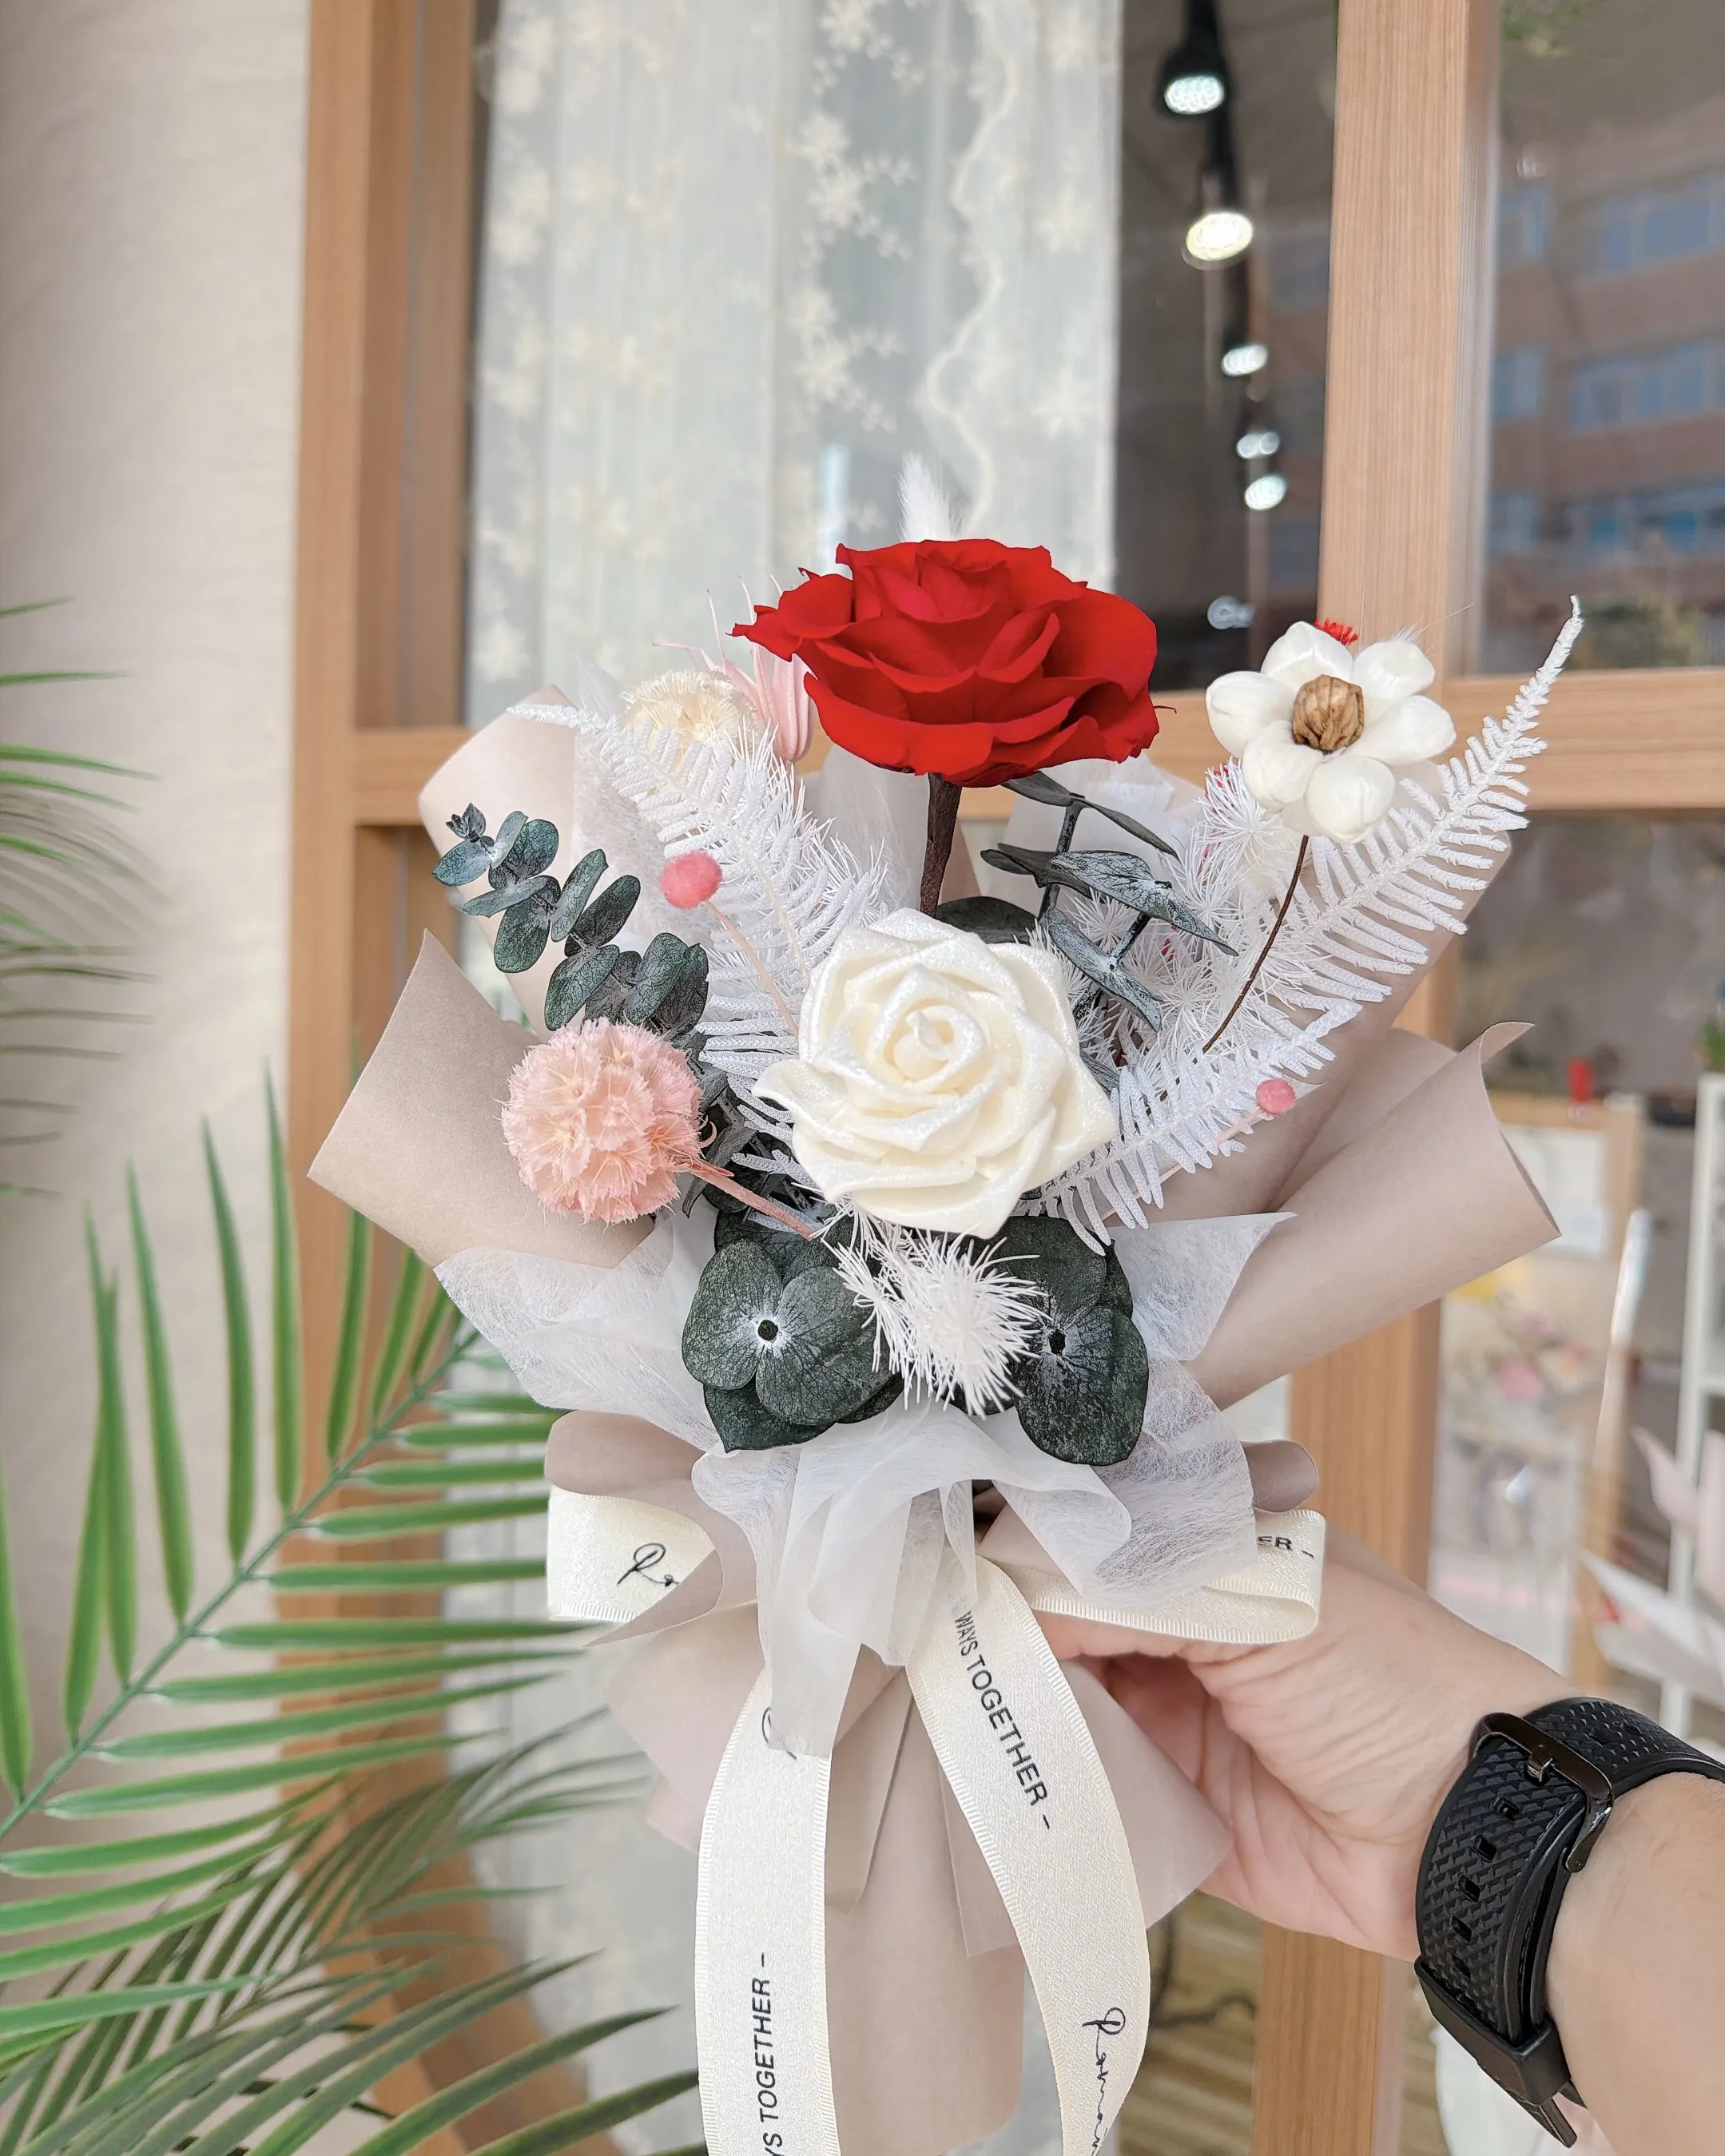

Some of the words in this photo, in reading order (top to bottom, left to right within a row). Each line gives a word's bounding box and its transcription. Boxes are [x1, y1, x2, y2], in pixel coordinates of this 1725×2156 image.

[952, 1602, 978, 1656] WAYS
[966, 1654, 1048, 1806] TOGETHER
[752, 1978, 779, 2122] TOGETHER
